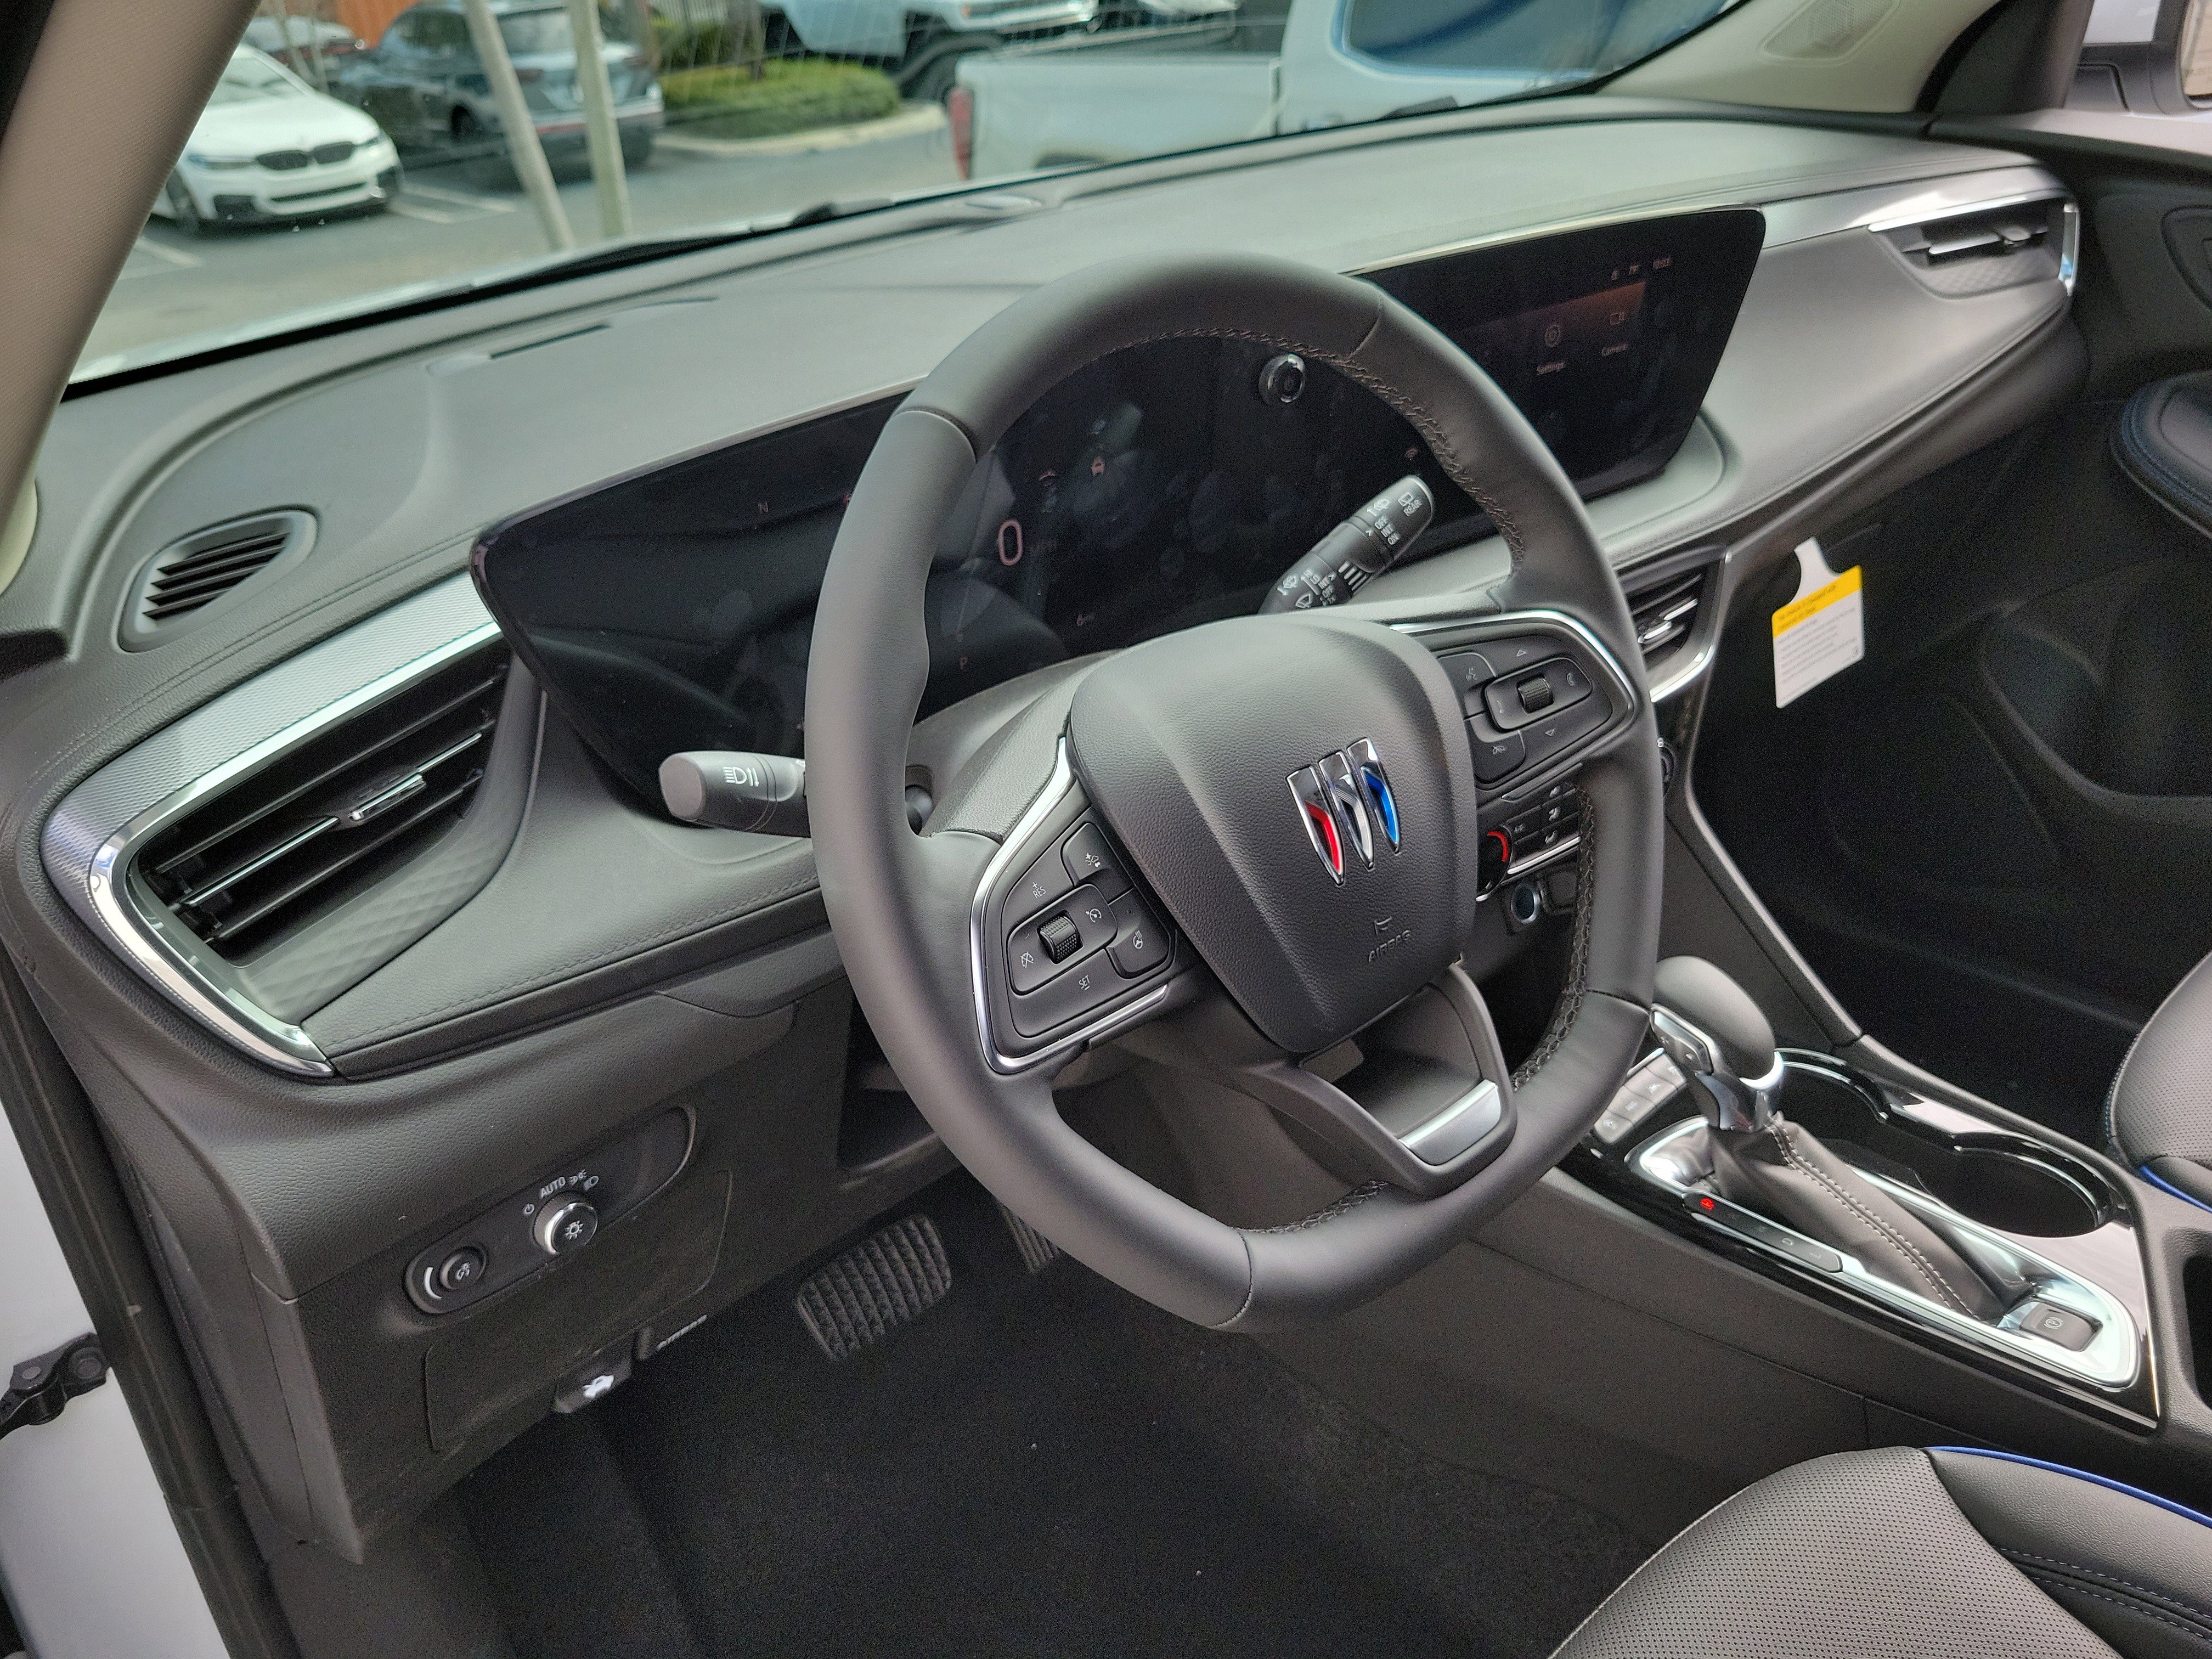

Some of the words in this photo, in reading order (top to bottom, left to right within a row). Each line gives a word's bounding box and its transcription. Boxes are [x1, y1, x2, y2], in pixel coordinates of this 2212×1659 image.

[1537, 361, 1566, 375] Settings
[1403, 500, 1421, 517] REAR
[1374, 516, 1387, 529] OFF
[1381, 523, 1394, 538] INT
[998, 519, 1023, 566] 0
[1387, 533, 1400, 545] ON
[1310, 575, 1321, 584] LO
[1318, 576, 1330, 589] INT
[1033, 886, 1046, 899] RES
[1368, 929, 1412, 963] AIRBAG
[1079, 975, 1091, 989] SET
[540, 1176, 566, 1199] AUTO
